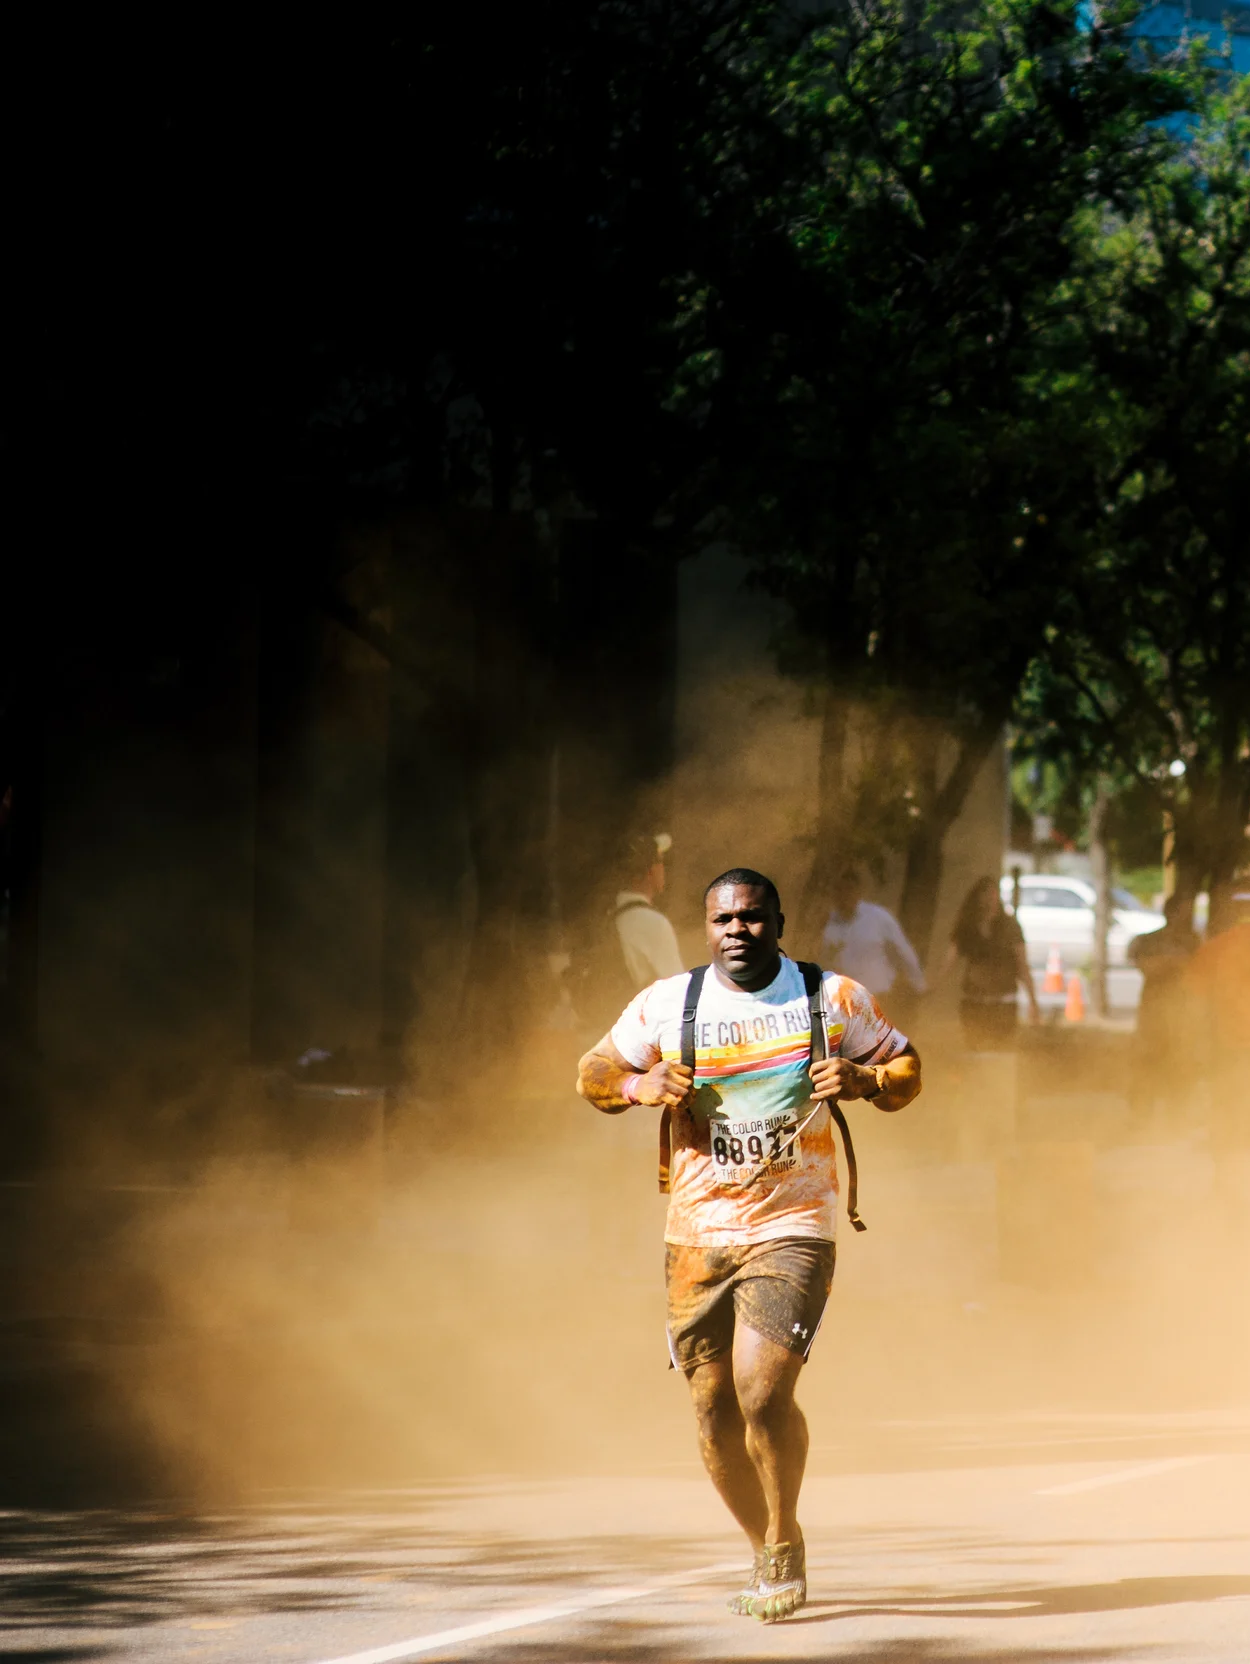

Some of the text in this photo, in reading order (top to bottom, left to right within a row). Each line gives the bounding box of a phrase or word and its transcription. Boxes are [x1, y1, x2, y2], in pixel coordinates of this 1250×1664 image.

[718, 1013, 780, 1046] COLOR
[783, 1007, 810, 1034] RU
[716, 1115, 783, 1135] THE COLOR RUN
[721, 1168, 739, 1180] THE
[771, 1160, 790, 1176] RUN
